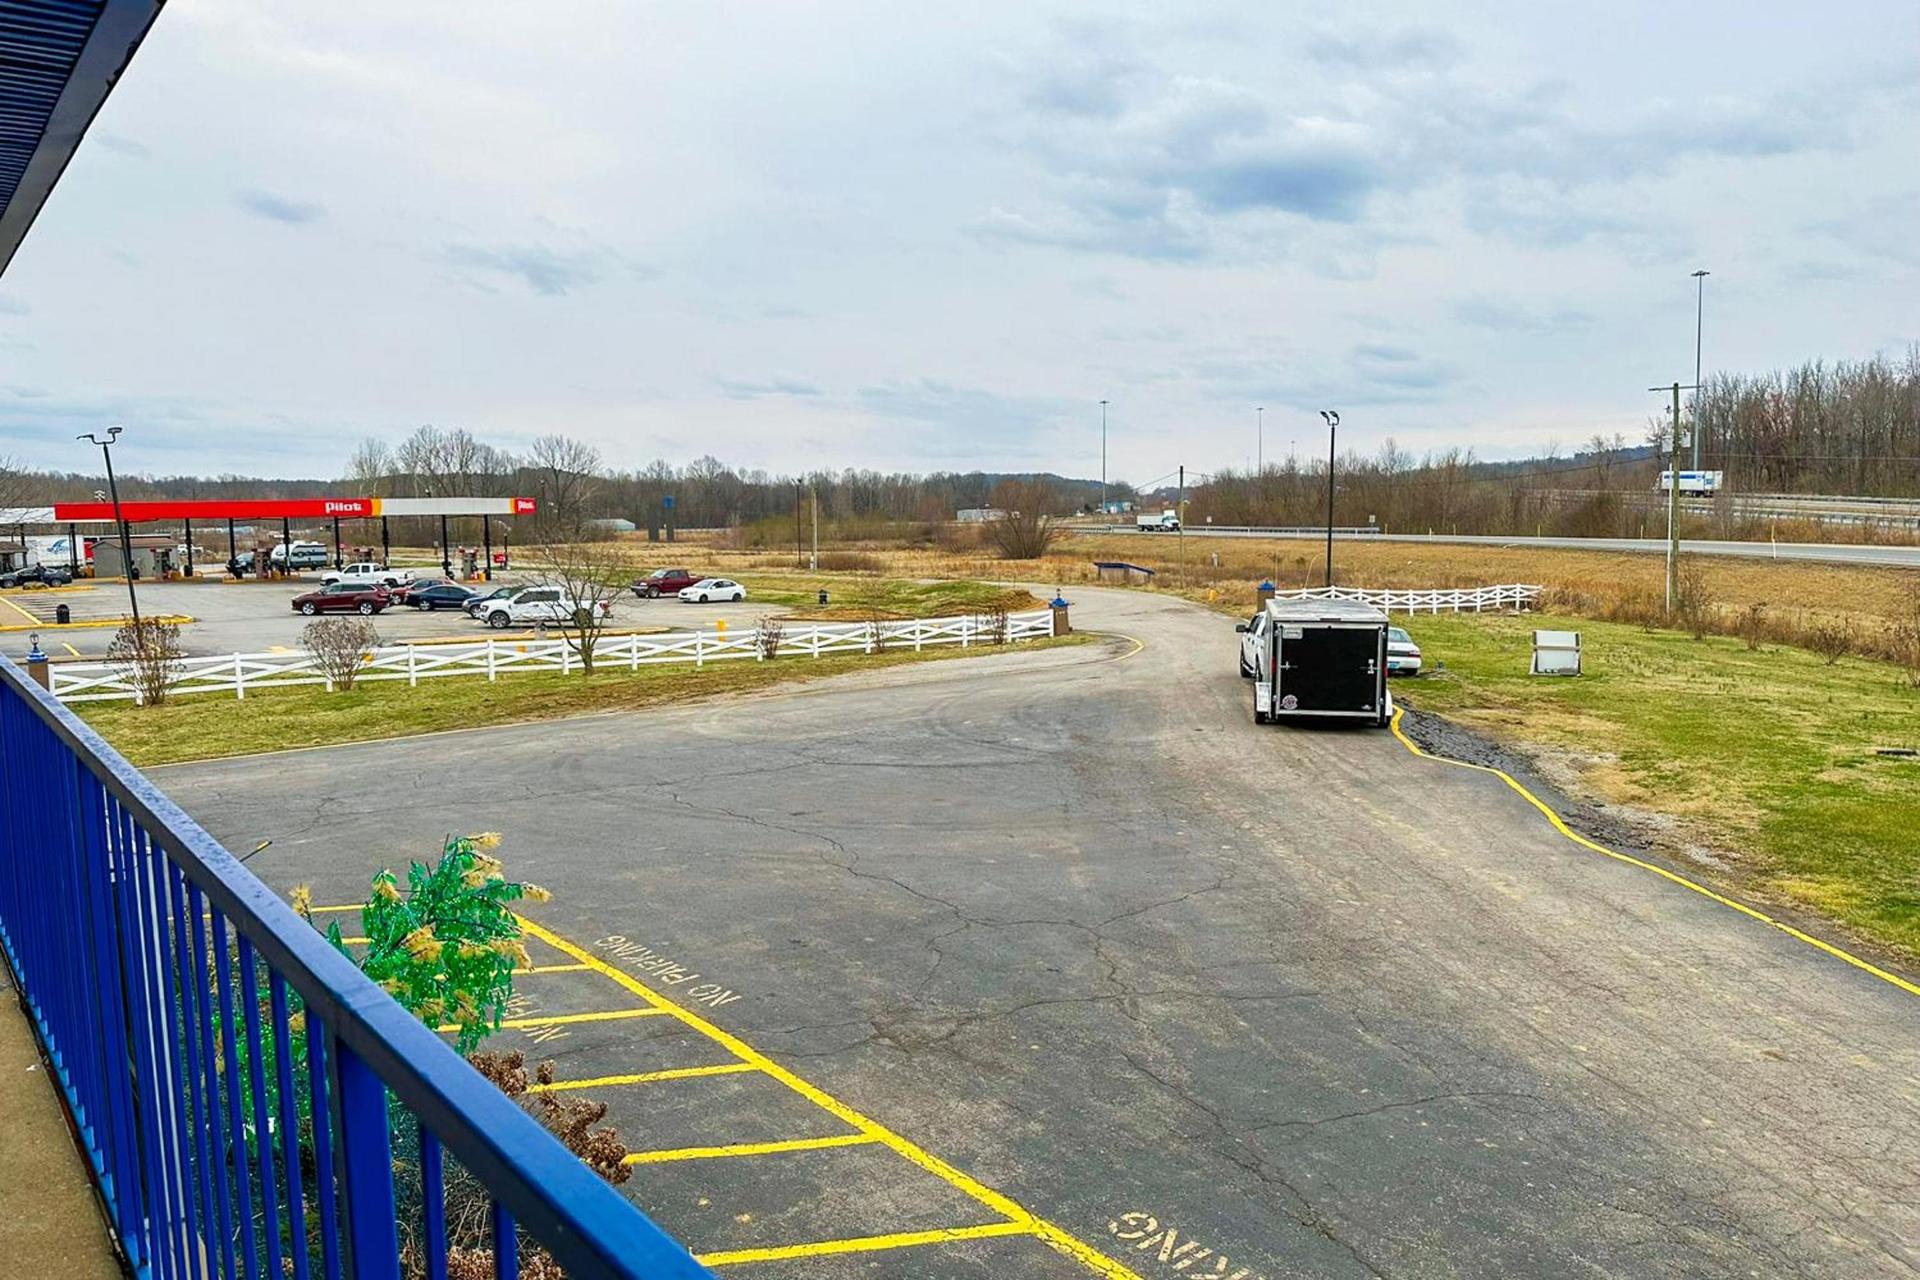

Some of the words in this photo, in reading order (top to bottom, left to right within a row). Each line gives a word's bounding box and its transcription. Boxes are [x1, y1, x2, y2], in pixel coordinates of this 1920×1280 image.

[593, 935, 700, 985] PARKING
[688, 983, 742, 1007] NO
[1107, 1211, 1265, 1280] KING
